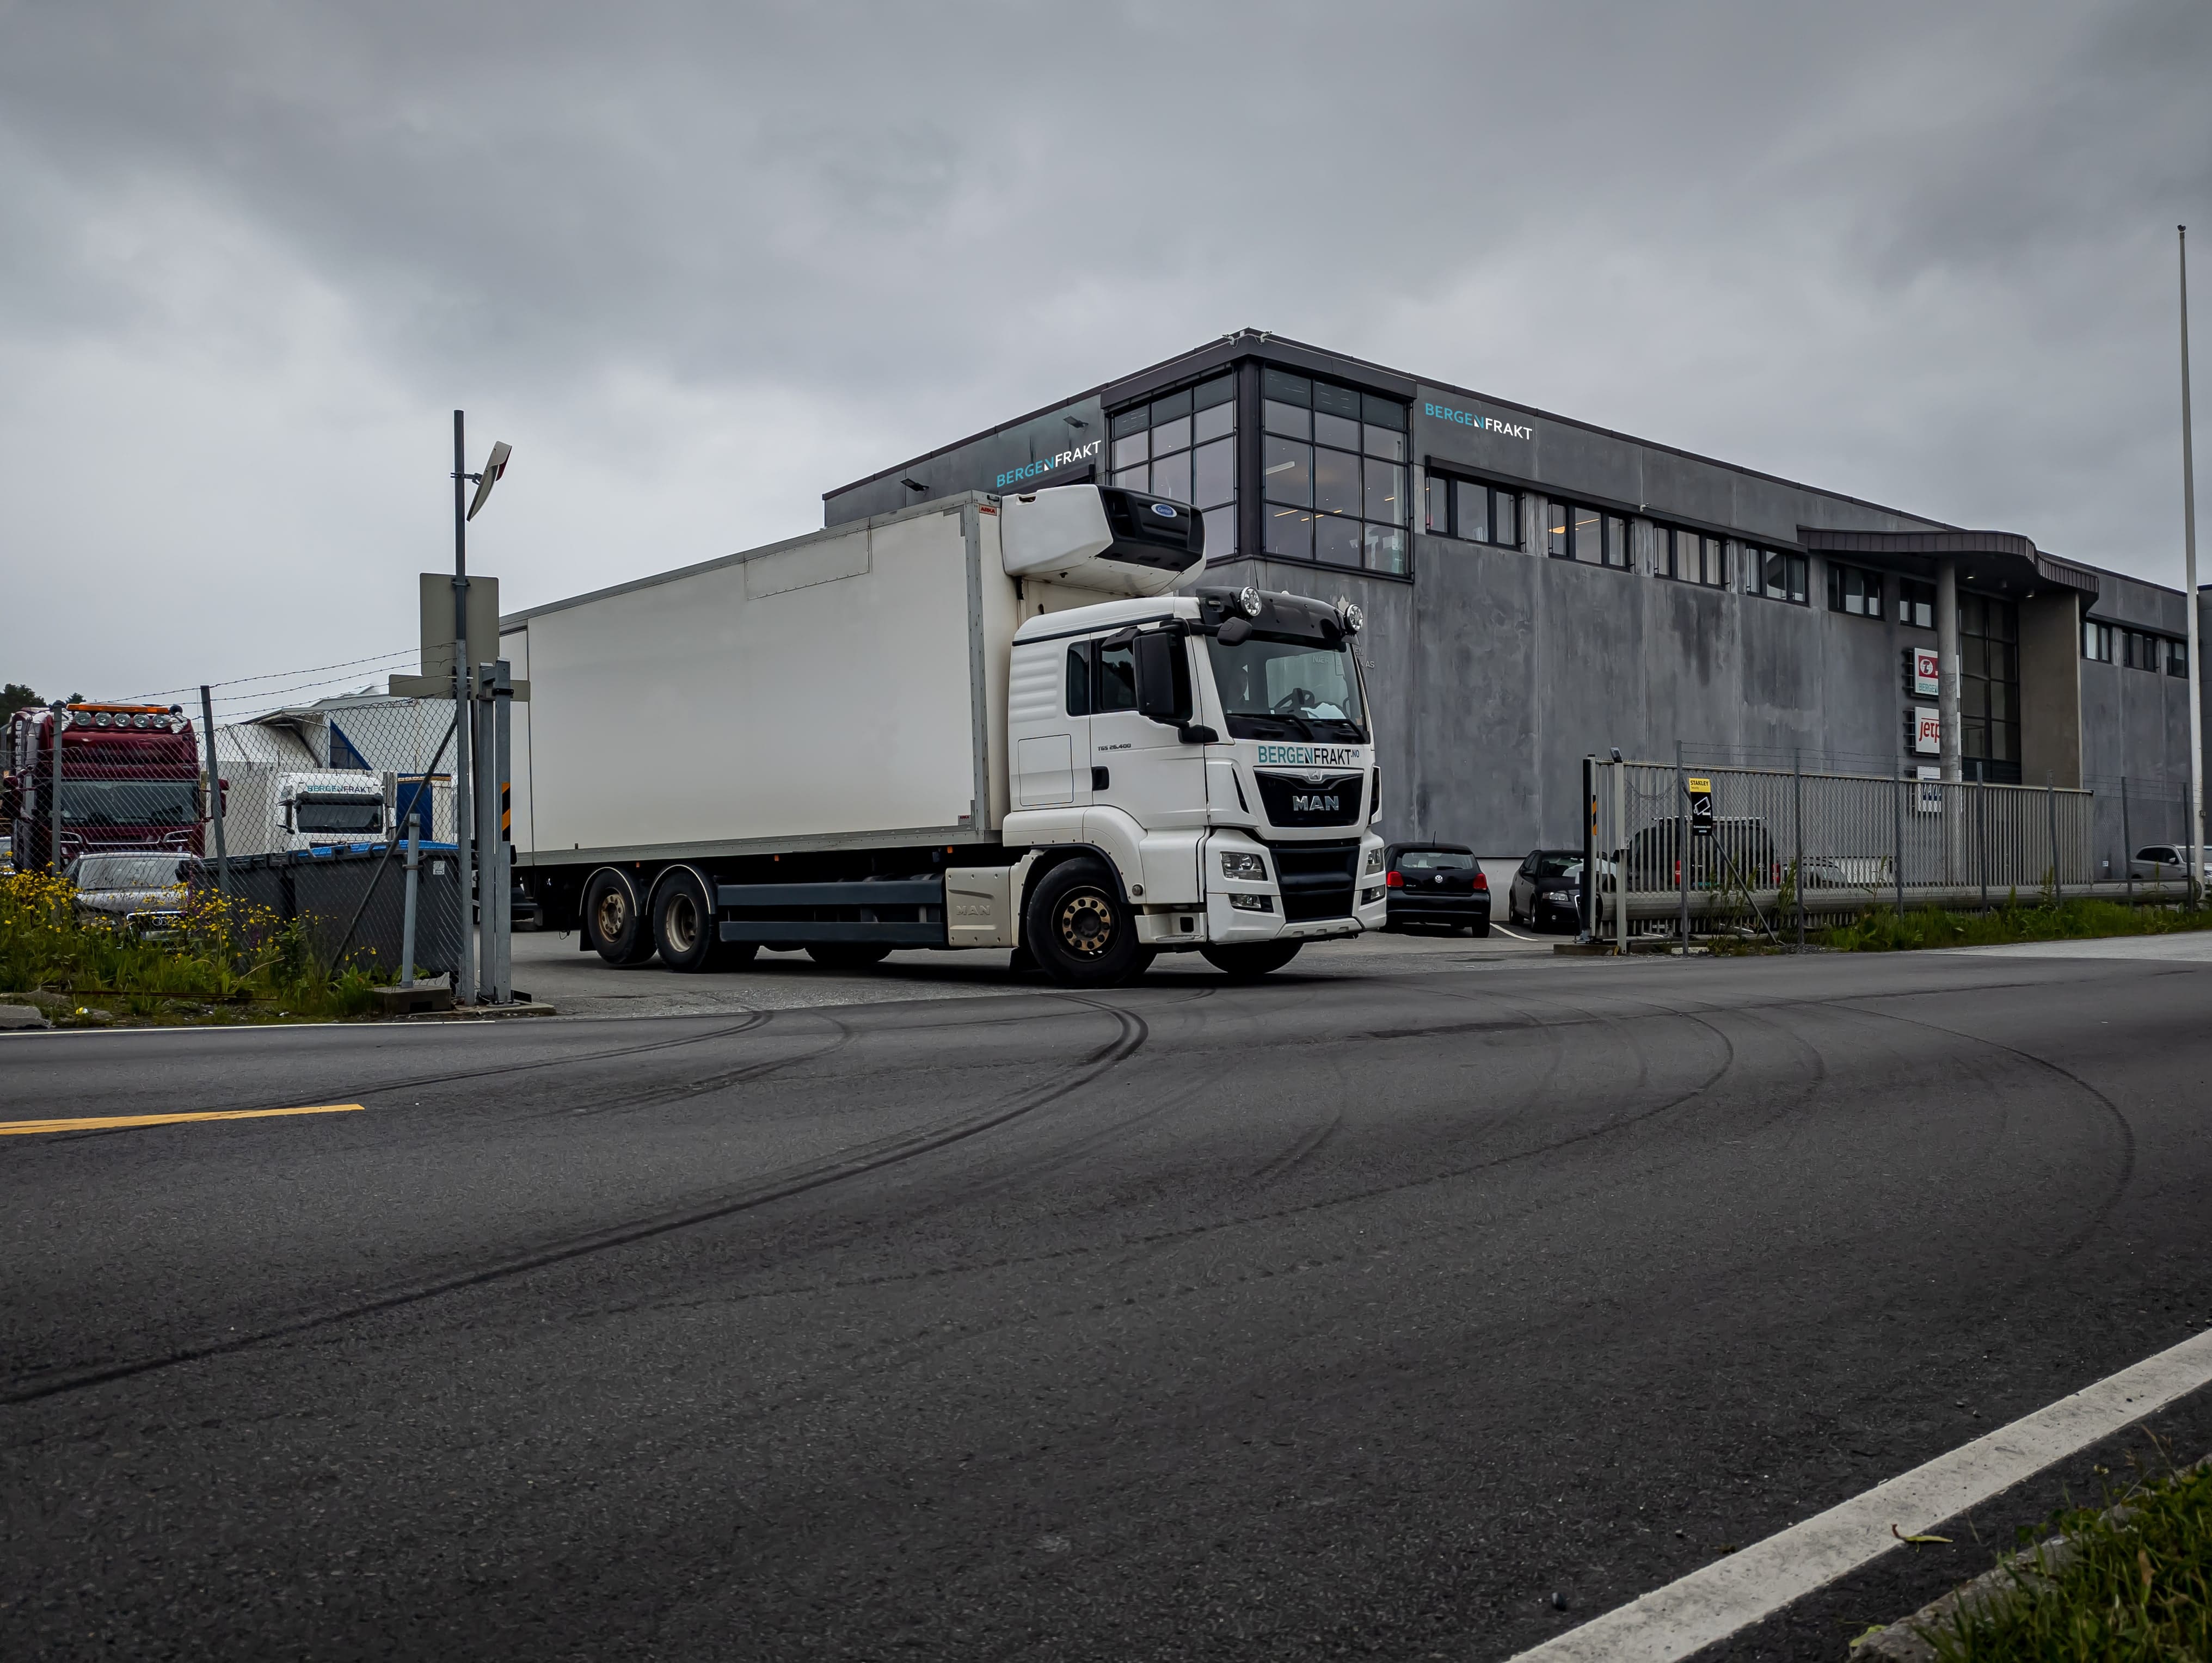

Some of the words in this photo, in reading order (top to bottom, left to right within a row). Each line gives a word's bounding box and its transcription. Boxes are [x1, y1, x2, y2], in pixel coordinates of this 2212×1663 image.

[1425, 403, 1533, 440] BERGENFRAKT
[997, 440, 1101, 487] BERGENFRAKT
[1293, 796, 1339, 811] MAN
[956, 905, 990, 915] MAN
